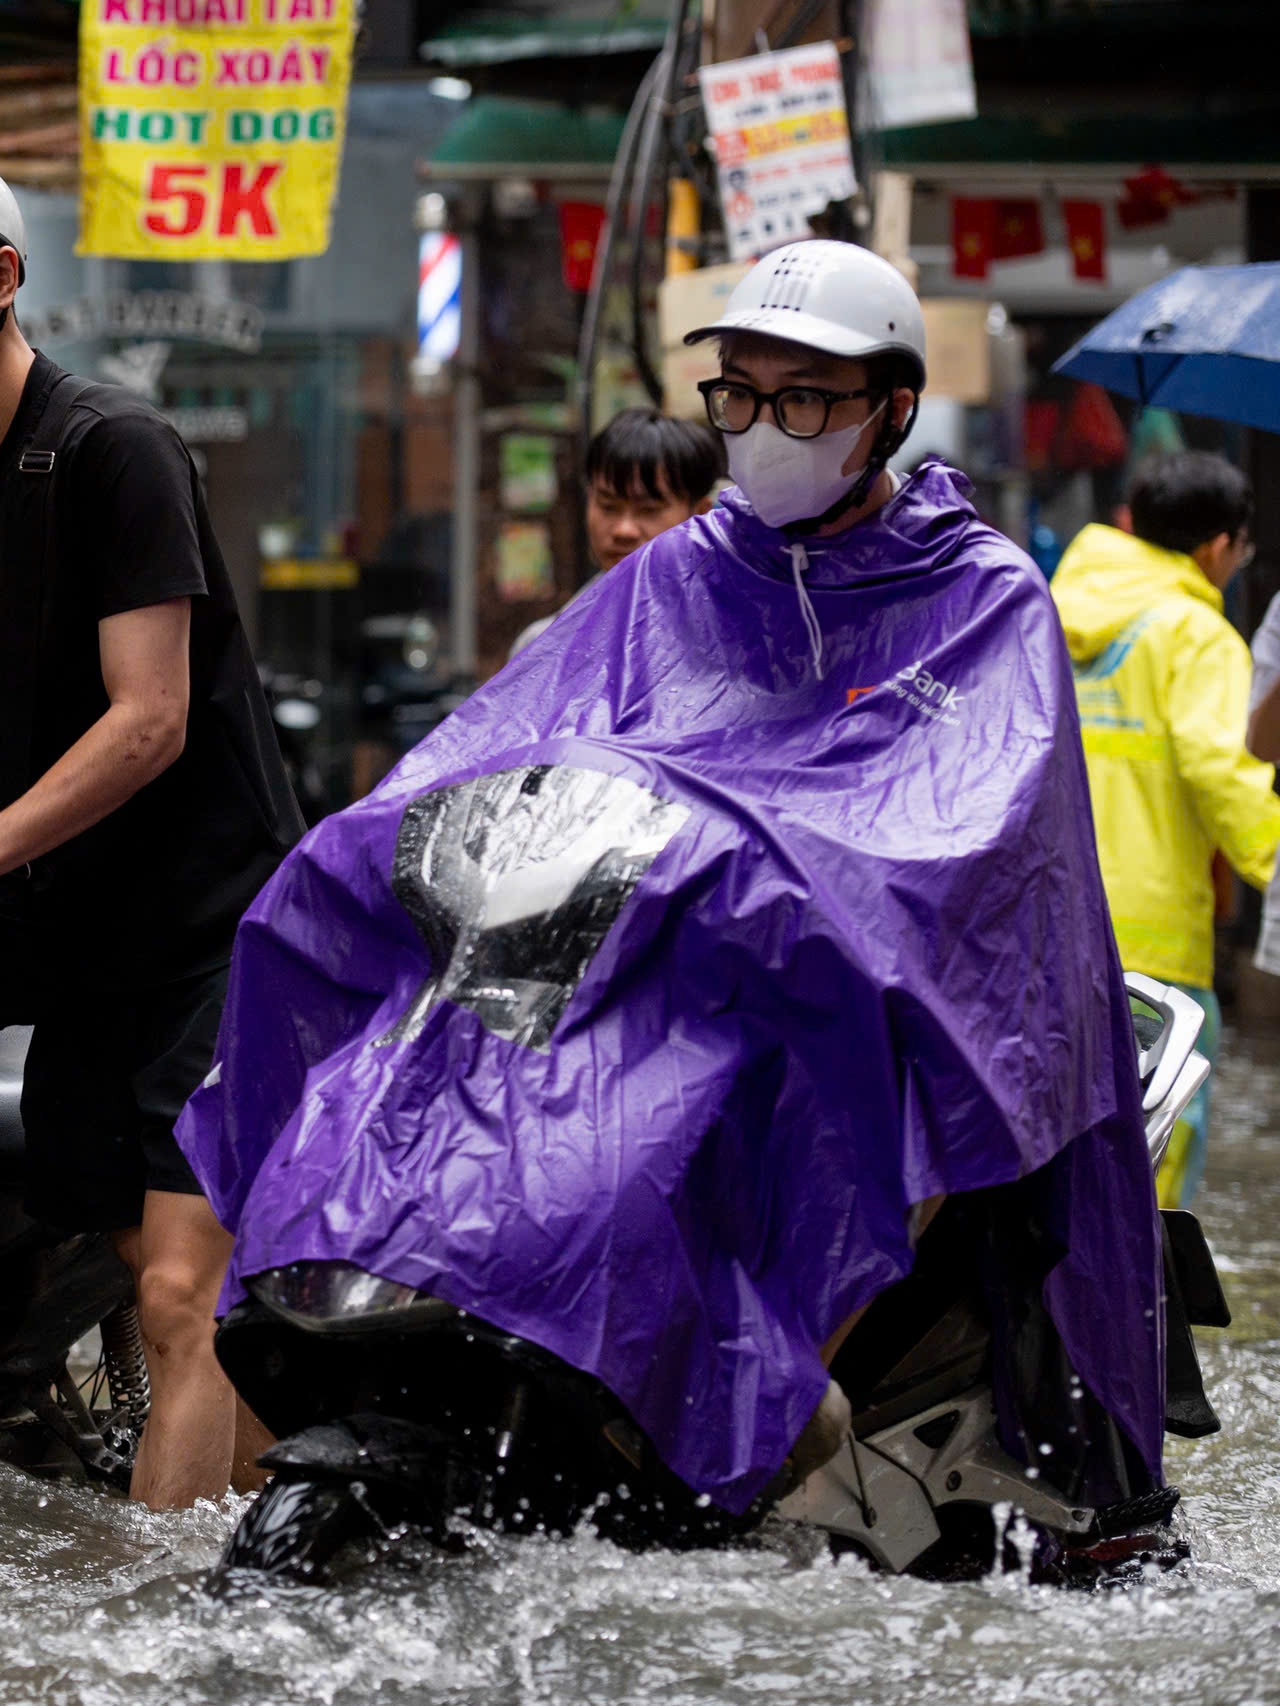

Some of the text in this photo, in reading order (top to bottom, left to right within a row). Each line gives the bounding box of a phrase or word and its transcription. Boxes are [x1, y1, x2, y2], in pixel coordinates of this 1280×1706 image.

[93, 107, 336, 143] HOT DOG
[142, 161, 284, 240] 5K
